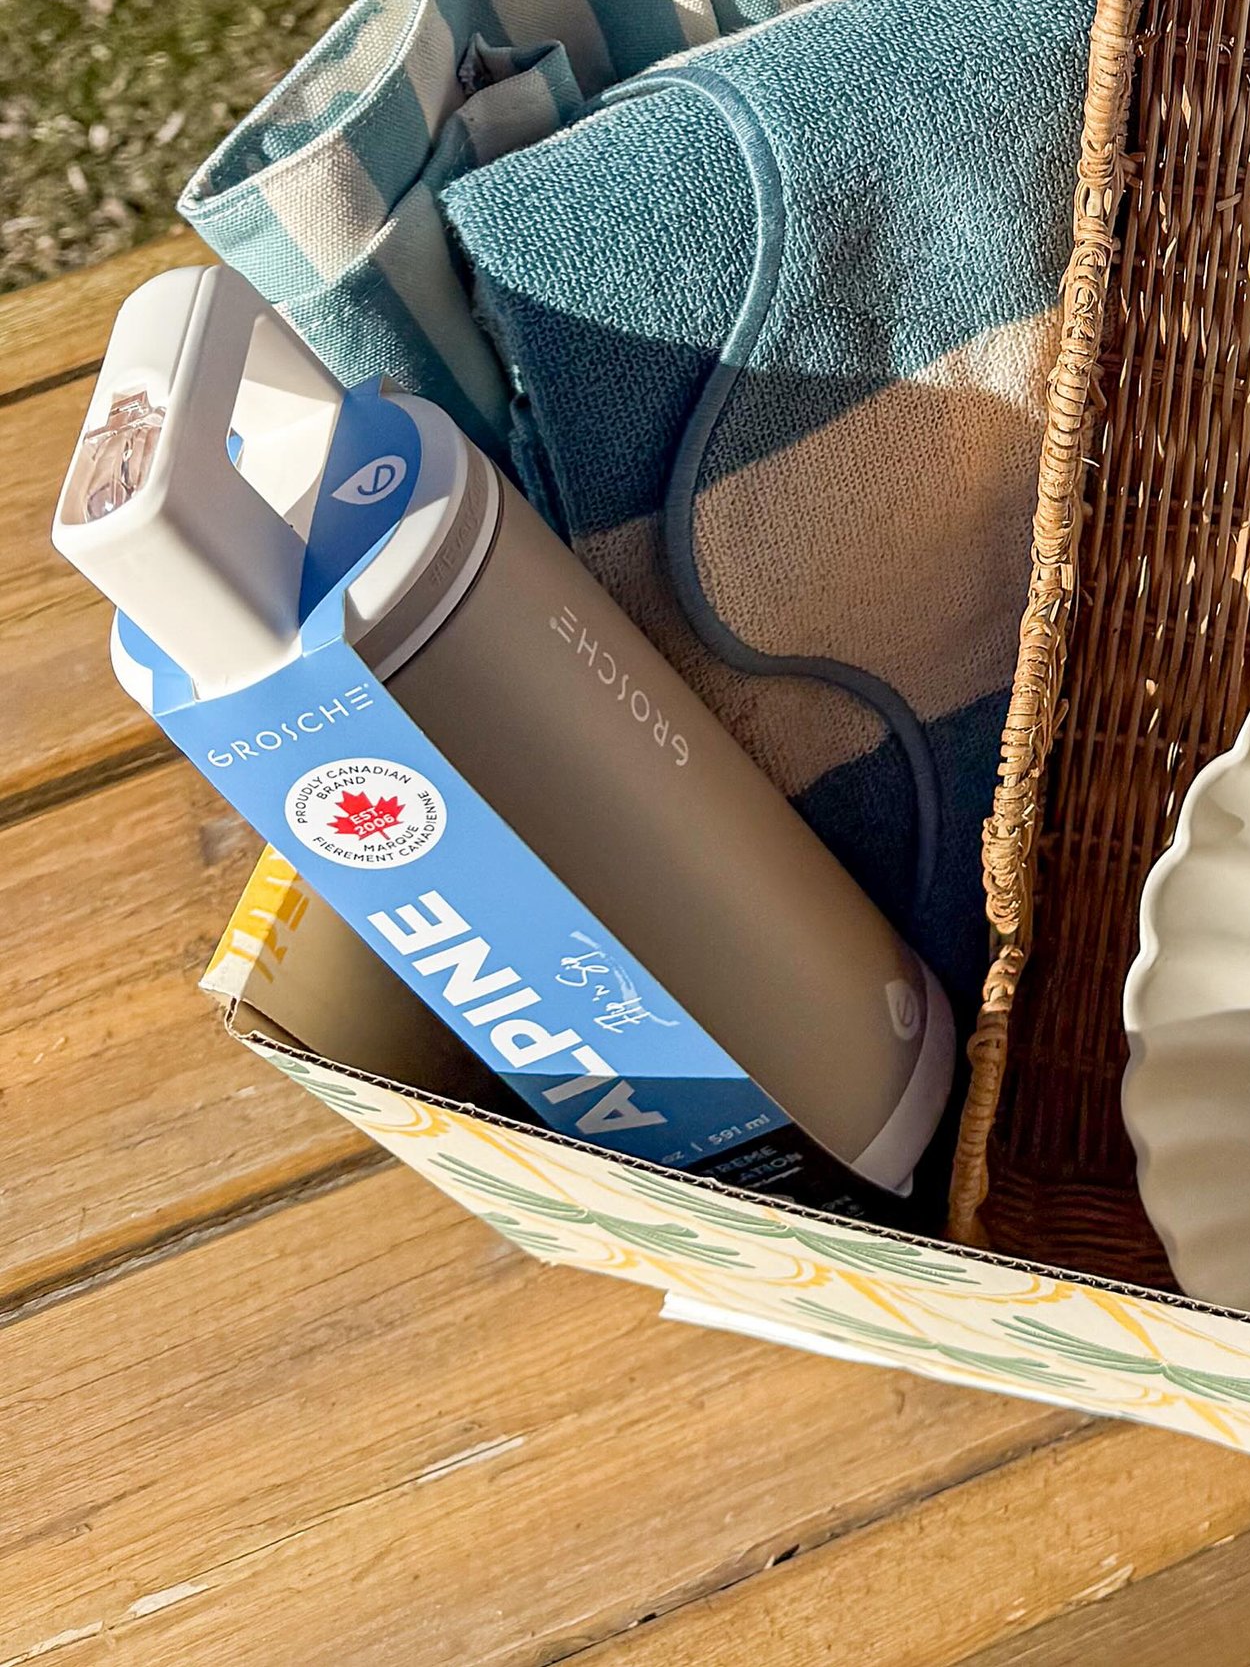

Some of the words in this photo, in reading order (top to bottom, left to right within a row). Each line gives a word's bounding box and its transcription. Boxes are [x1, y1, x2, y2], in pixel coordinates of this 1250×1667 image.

[555, 605, 690, 766] GROSCHE
[206, 684, 374, 768] GROSCHE
[295, 776, 324, 824] PROUDLY
[326, 765, 413, 785] CANADIAN
[316, 776, 366, 801] BRAND
[349, 806, 384, 825] EST.
[353, 813, 395, 836] 2006
[398, 789, 438, 857] CANADIENNE
[363, 824, 420, 853] MARQUE
[366, 889, 668, 1135] ALPINE
[707, 1125, 743, 1146] 591
